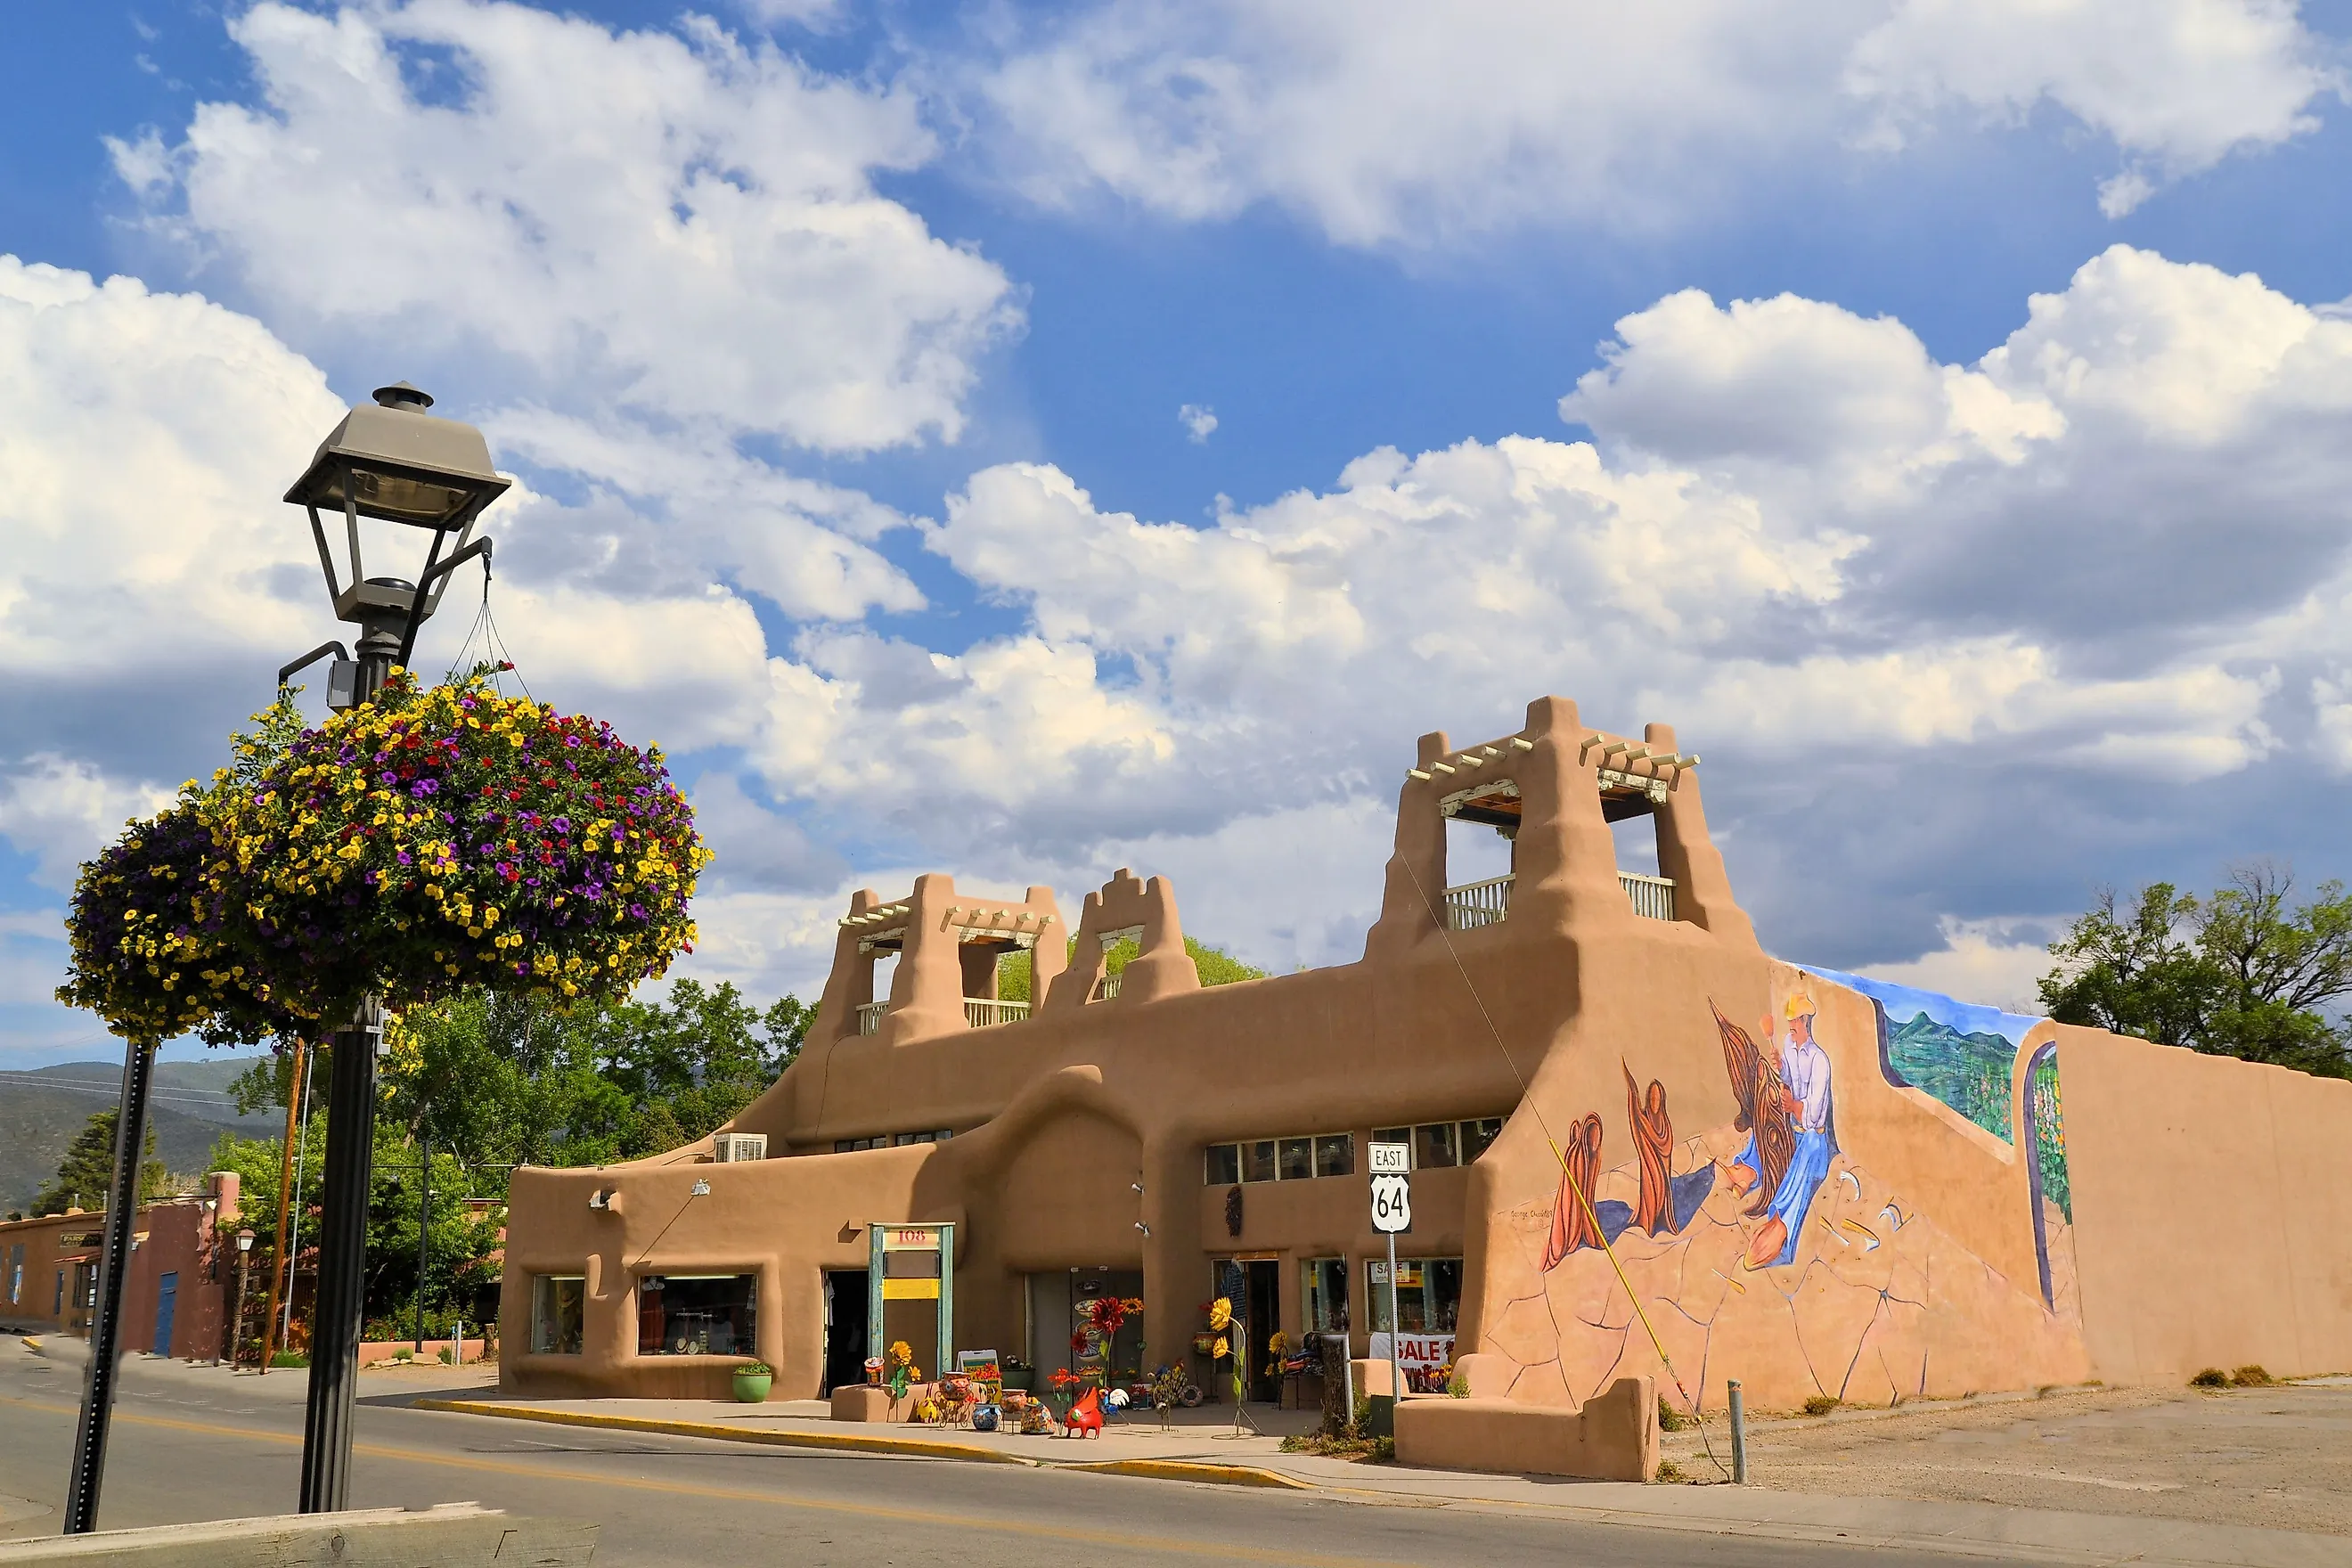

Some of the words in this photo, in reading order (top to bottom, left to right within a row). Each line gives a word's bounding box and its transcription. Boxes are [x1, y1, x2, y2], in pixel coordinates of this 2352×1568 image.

[1376, 1150, 1401, 1166] EAST
[1377, 1187, 1403, 1218] 64
[899, 1229, 926, 1243] 108
[1377, 1263, 1402, 1274] SAE
